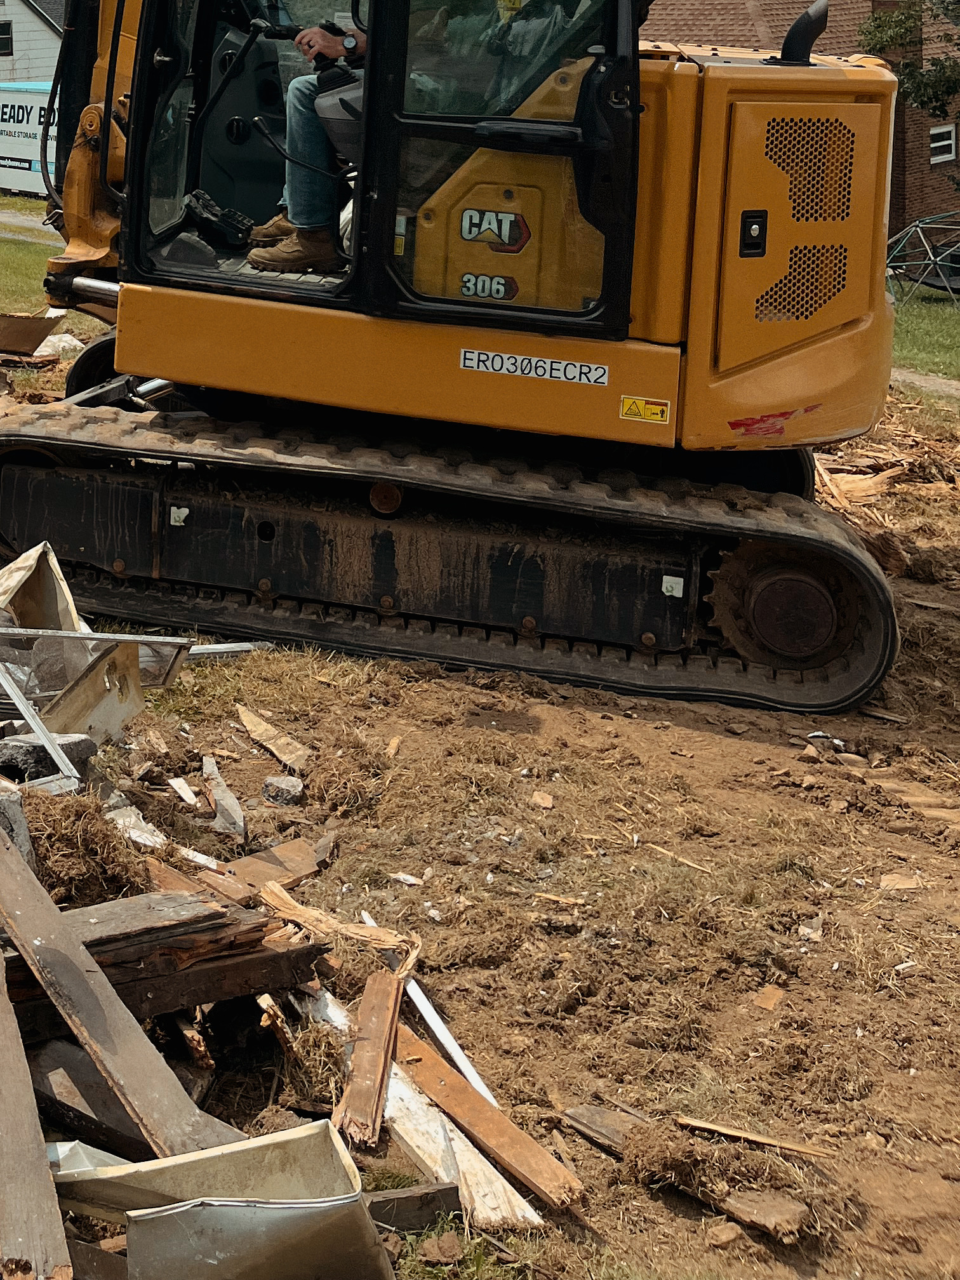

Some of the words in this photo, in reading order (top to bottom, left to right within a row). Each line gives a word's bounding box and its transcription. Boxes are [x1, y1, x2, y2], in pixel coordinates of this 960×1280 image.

[17, 131, 38, 140] STORAGE
[461, 209, 515, 244] CAT
[461, 274, 506, 299] 306
